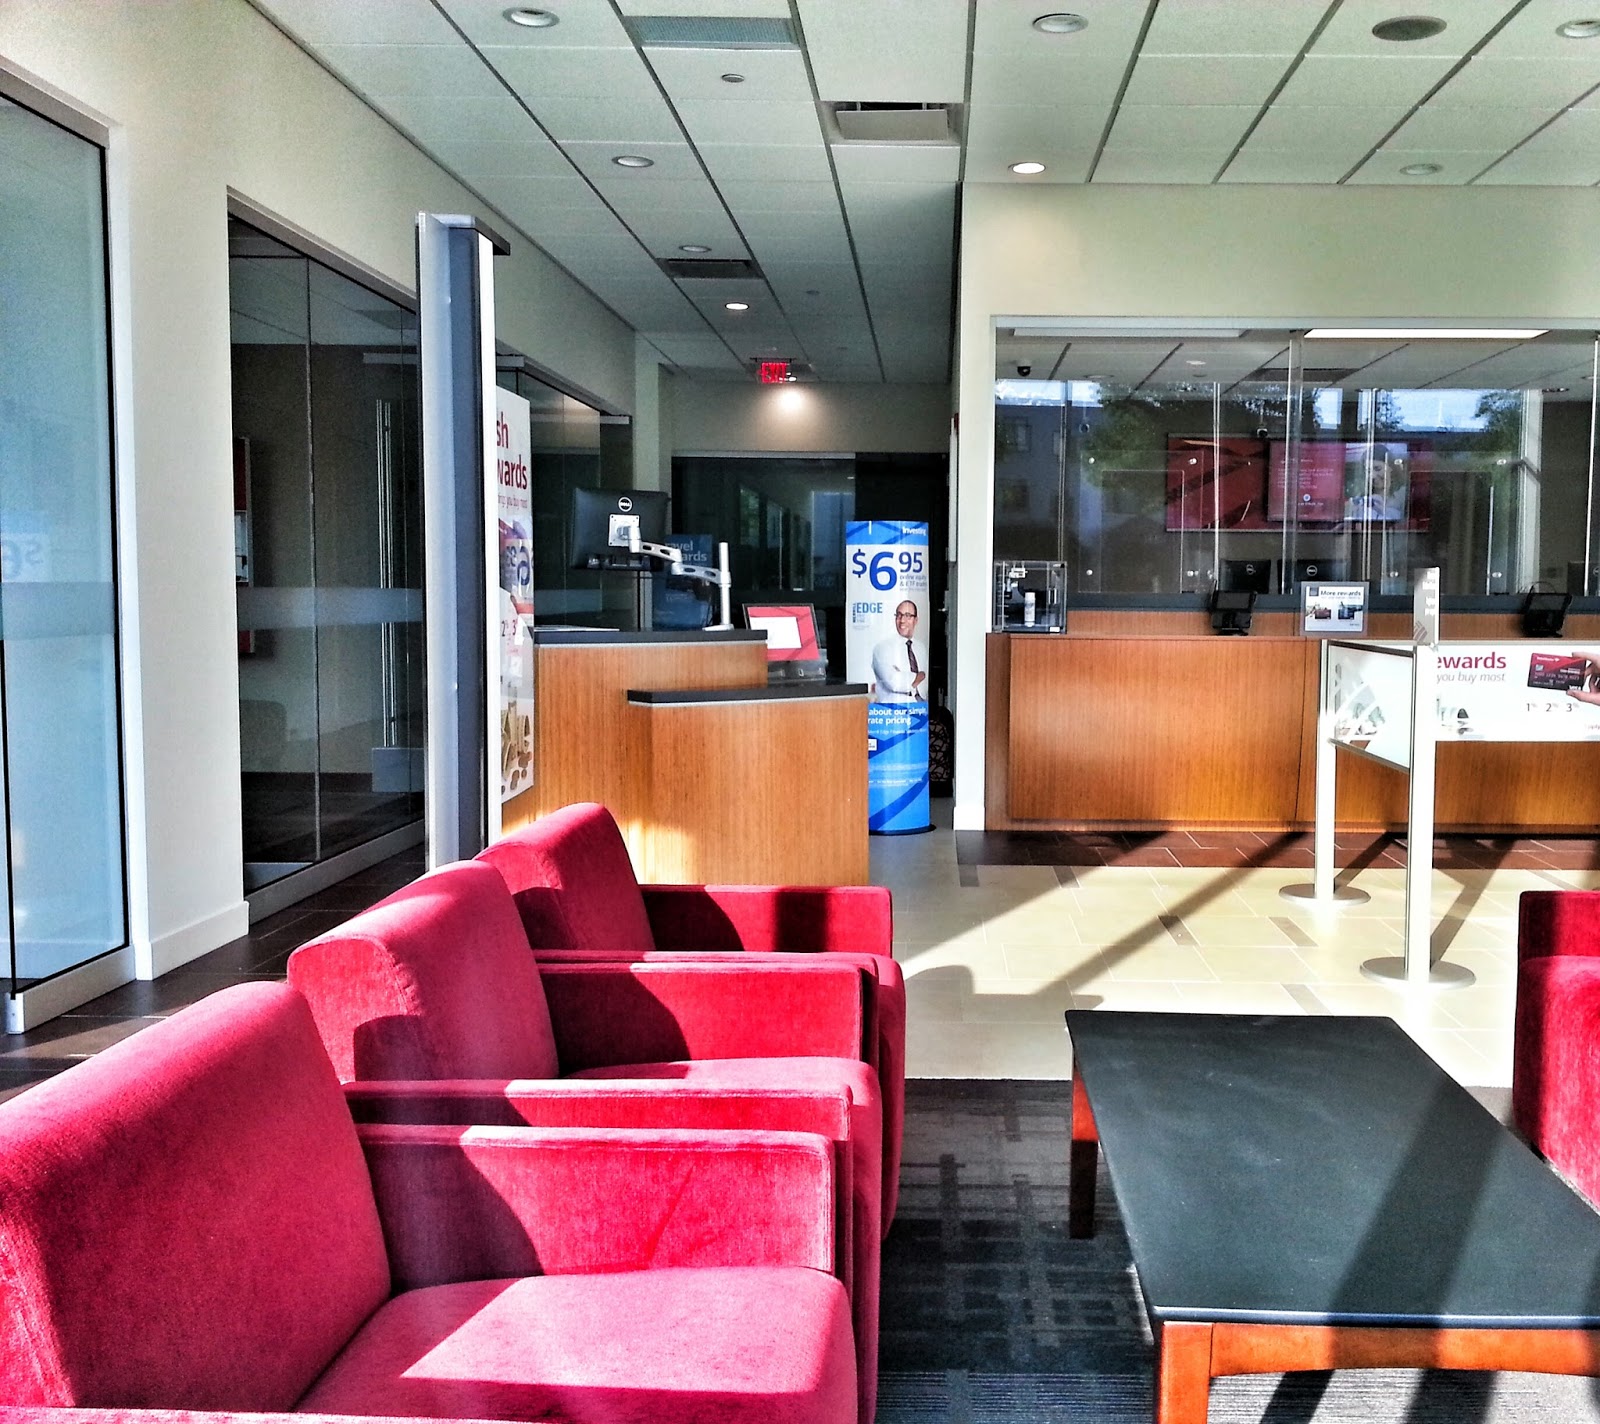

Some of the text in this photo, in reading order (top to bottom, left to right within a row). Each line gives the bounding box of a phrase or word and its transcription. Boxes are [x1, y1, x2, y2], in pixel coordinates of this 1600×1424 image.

[856, 602, 883, 614] EDGE
[1436, 671, 1505, 684] you buy most
[868, 707, 892, 716] about
[867, 715, 912, 727] rate pricing
